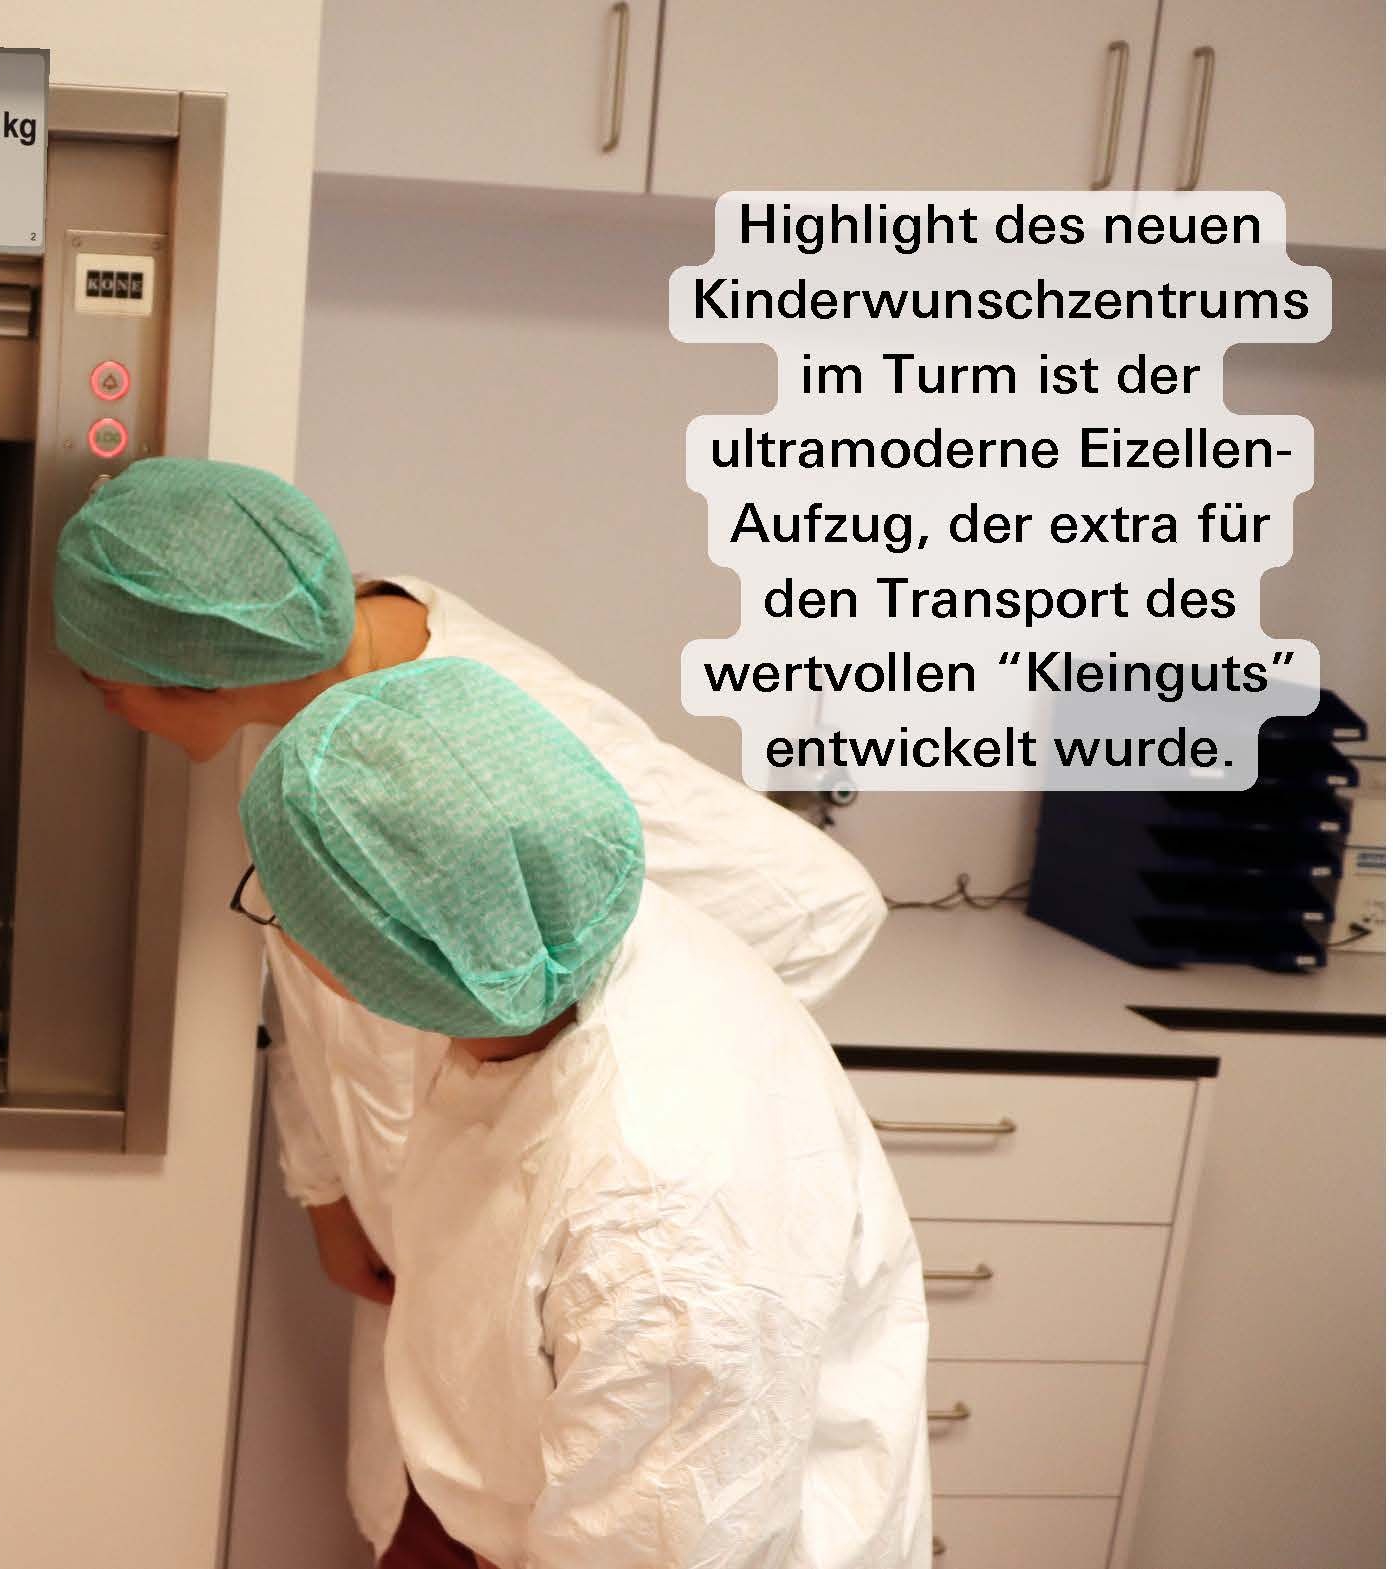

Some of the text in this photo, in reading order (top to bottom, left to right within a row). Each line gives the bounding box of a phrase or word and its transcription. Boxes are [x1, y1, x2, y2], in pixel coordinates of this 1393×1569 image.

[3, 111, 37, 146] kg
[30, 231, 37, 242] 2
[87, 277, 143, 293] KONE
